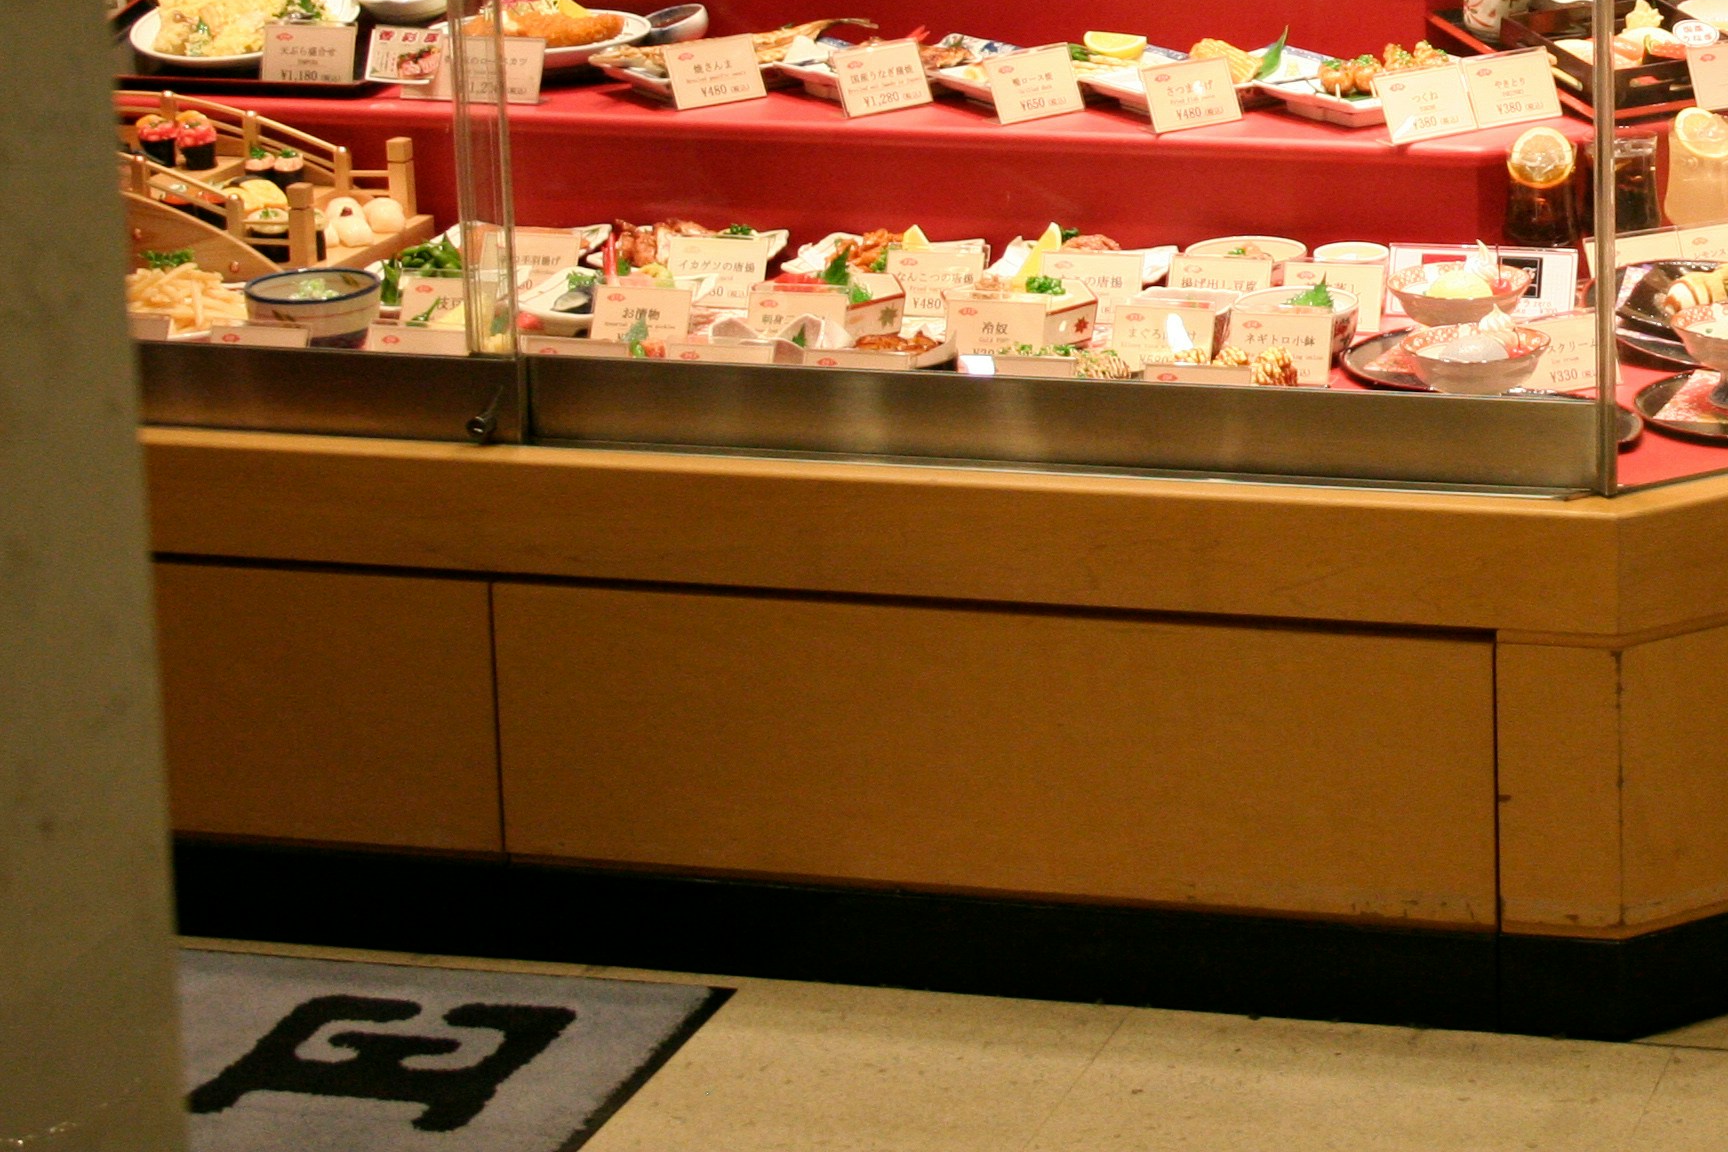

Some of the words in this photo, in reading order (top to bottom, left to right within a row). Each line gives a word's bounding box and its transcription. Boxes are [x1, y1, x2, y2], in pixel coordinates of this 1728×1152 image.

[692, 61, 733, 76] 焼さんま
[700, 83, 728, 97] ¥480
[862, 90, 901, 107] ¥1,280
[1019, 97, 1046, 112] ¥650
[1175, 106, 1203, 121] ¥480
[1495, 100, 1523, 114] ¥380
[897, 270, 975, 286] なんこつの唐揚
[911, 297, 943, 311] ¥480
[980, 320, 1009, 335] 冷奴
[1245, 333, 1316, 347] ネギトロ小鉢
[1549, 368, 1579, 385] ¥330
